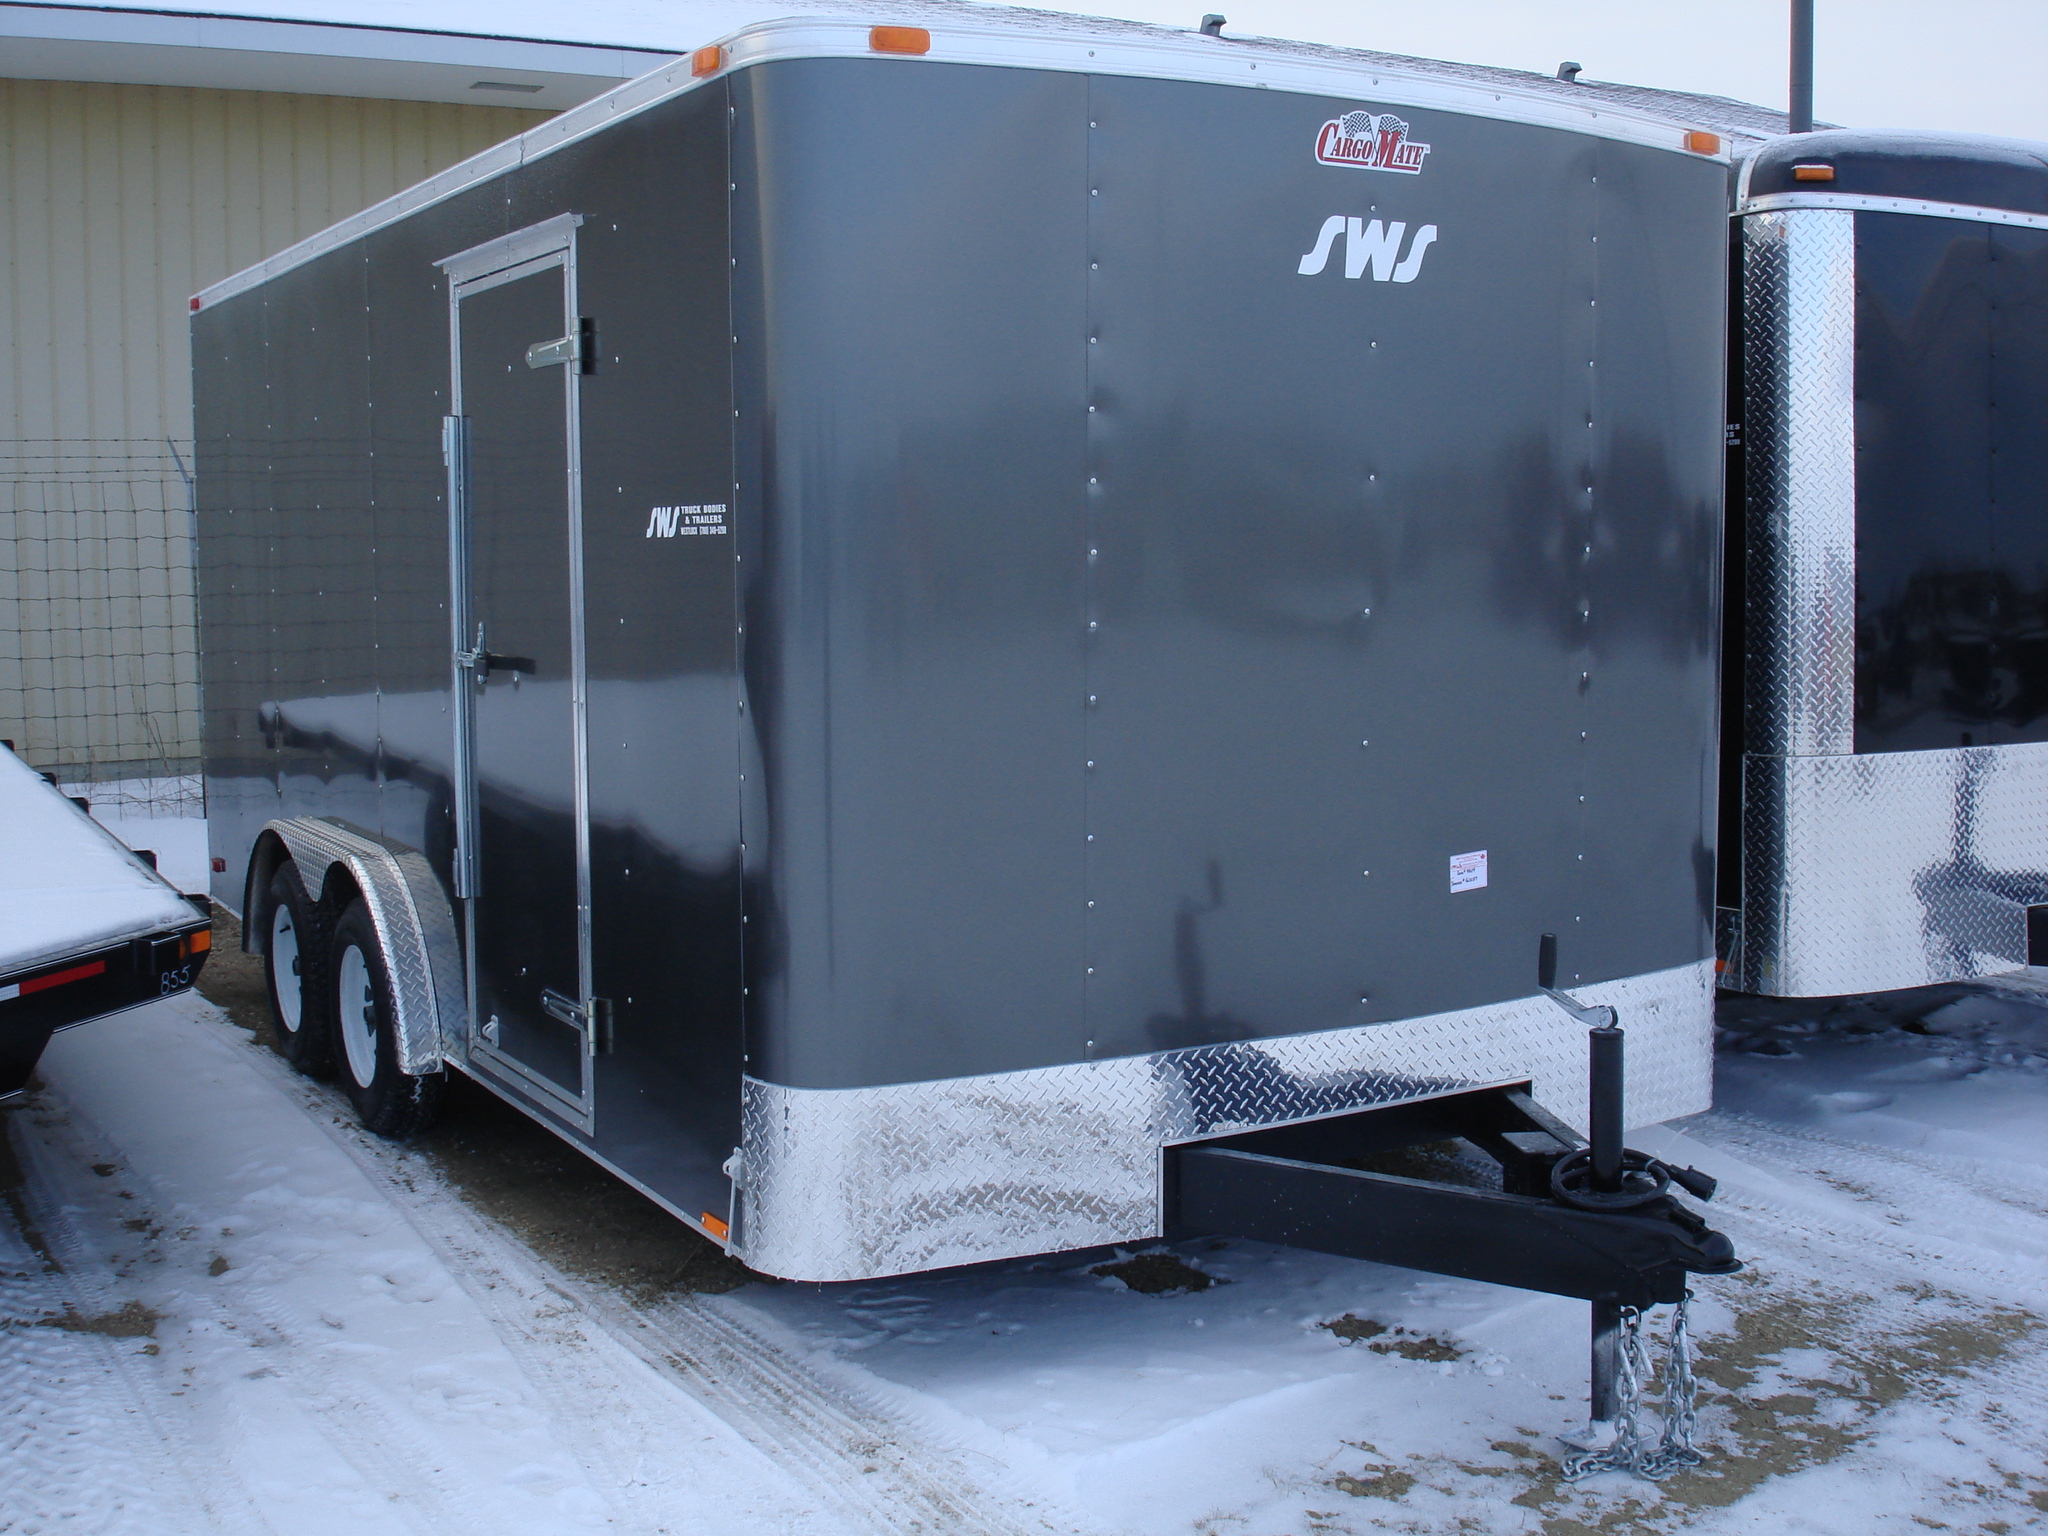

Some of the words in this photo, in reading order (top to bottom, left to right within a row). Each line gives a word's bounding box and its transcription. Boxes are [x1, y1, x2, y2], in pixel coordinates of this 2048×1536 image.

[1317, 122, 1373, 162] CARGO
[1371, 130, 1424, 168] MATE
[1297, 214, 1438, 284] SWS
[645, 505, 681, 539] SWS
[680, 504, 702, 515] TRUCK
[703, 503, 727, 514] BODIES
[684, 515, 690, 525] &
[691, 514, 723, 525] TRAILERS
[160, 963, 191, 996] 855
